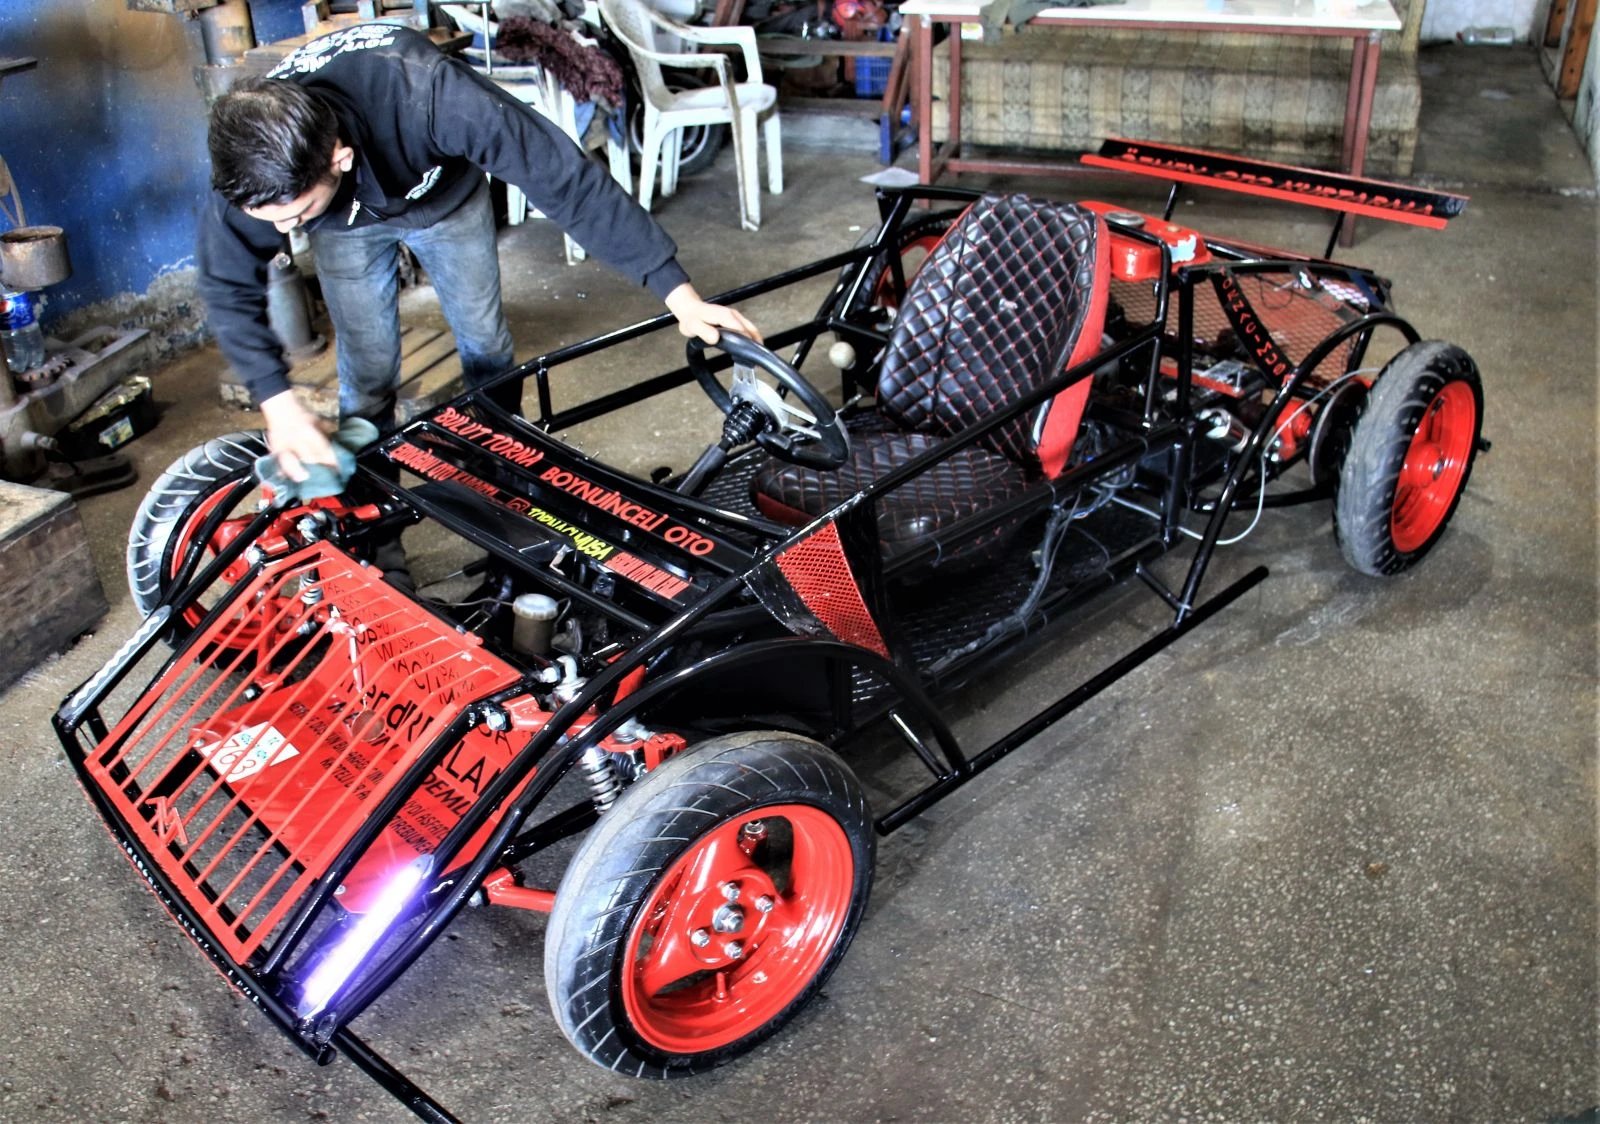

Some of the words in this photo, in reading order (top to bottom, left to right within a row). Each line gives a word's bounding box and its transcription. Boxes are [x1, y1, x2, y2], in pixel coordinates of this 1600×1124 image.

[434, 407, 491, 442] BULUT
[489, 432, 545, 467] TORNA
[540, 465, 670, 531] BOYNUİNCELİ
[664, 524, 715, 557] OTO
